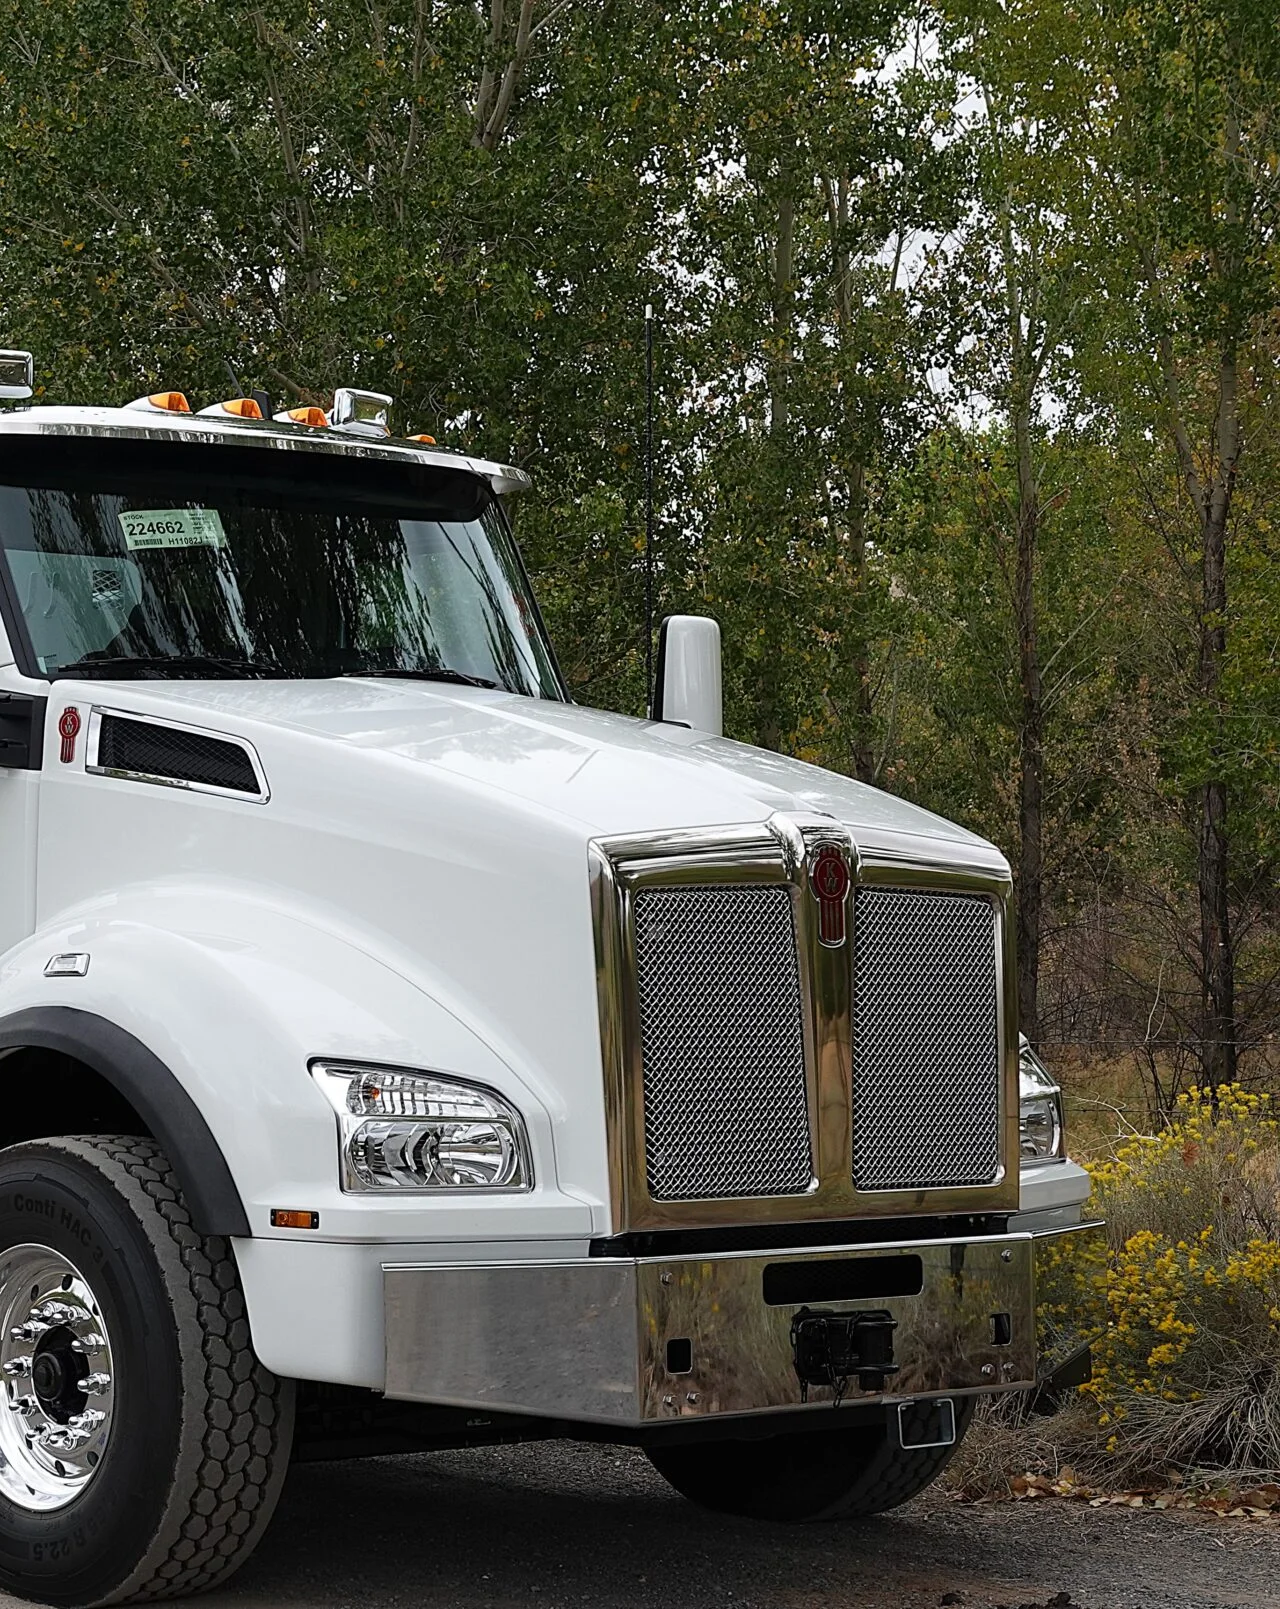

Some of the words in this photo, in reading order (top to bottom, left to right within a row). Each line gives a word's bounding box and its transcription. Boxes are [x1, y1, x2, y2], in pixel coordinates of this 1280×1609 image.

[126, 521, 185, 536] 224662
[168, 537, 203, 545] H11082J
[13, 1193, 57, 1219] Conti
[60, 1206, 92, 1247] HAC
[33, 1536, 70, 1561] 22.5
